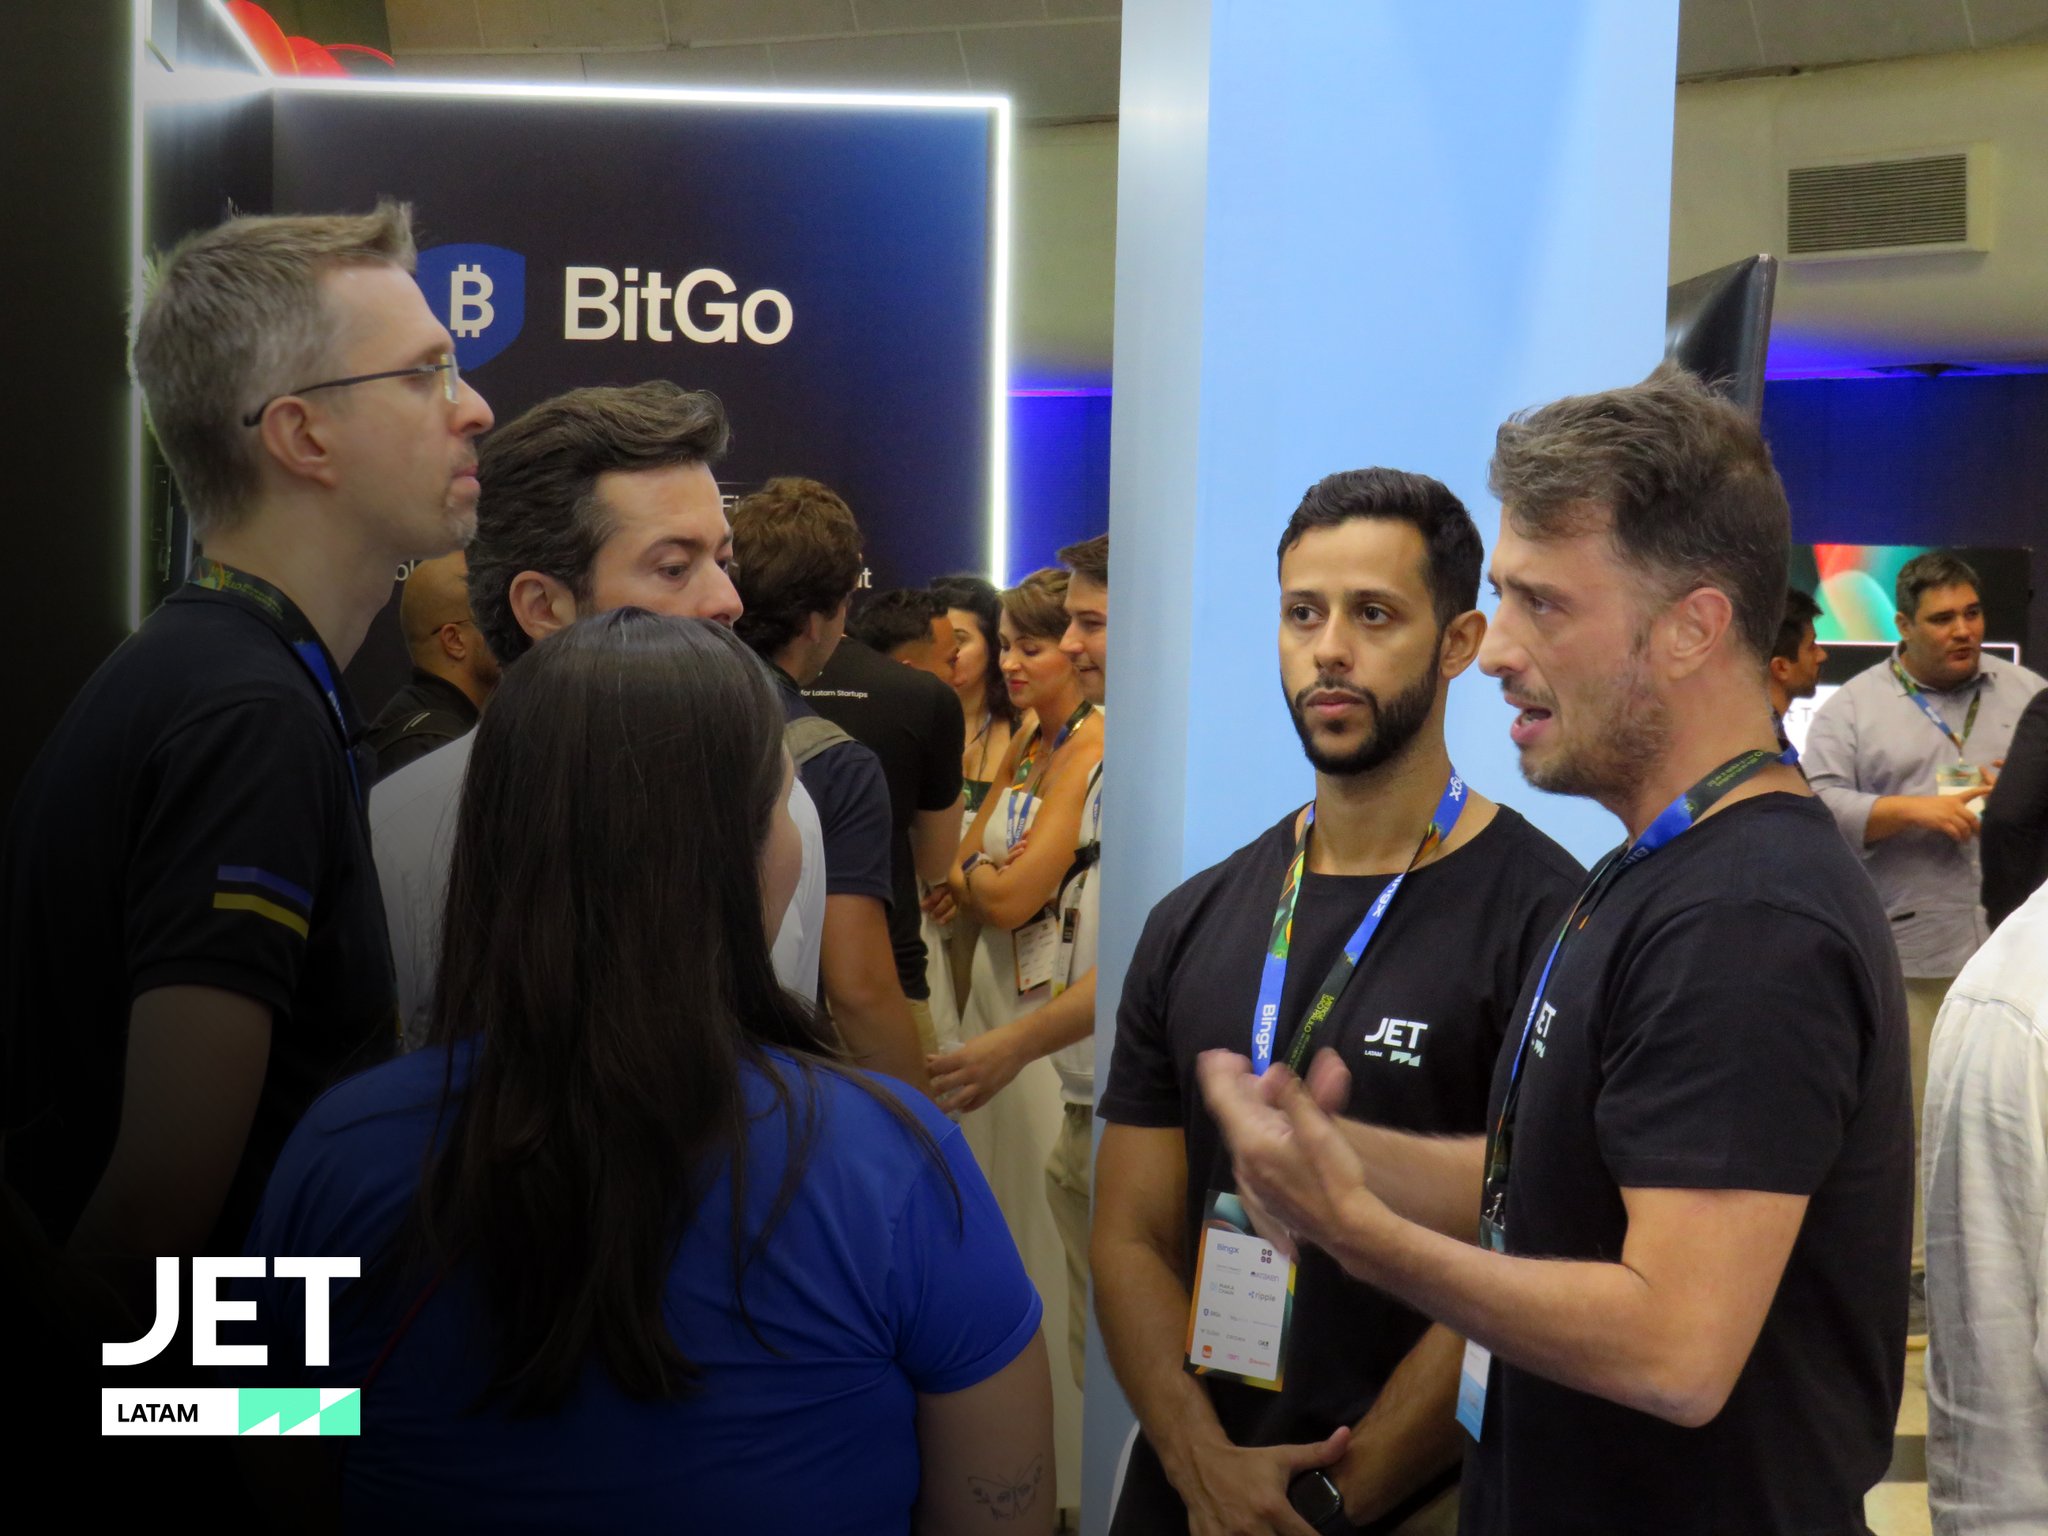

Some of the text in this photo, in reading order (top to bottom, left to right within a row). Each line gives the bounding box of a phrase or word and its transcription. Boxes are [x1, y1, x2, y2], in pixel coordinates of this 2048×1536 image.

[564, 266, 794, 345] BitGo
[837, 690, 868, 699] Startups
[1364, 1017, 1429, 1049] JET
